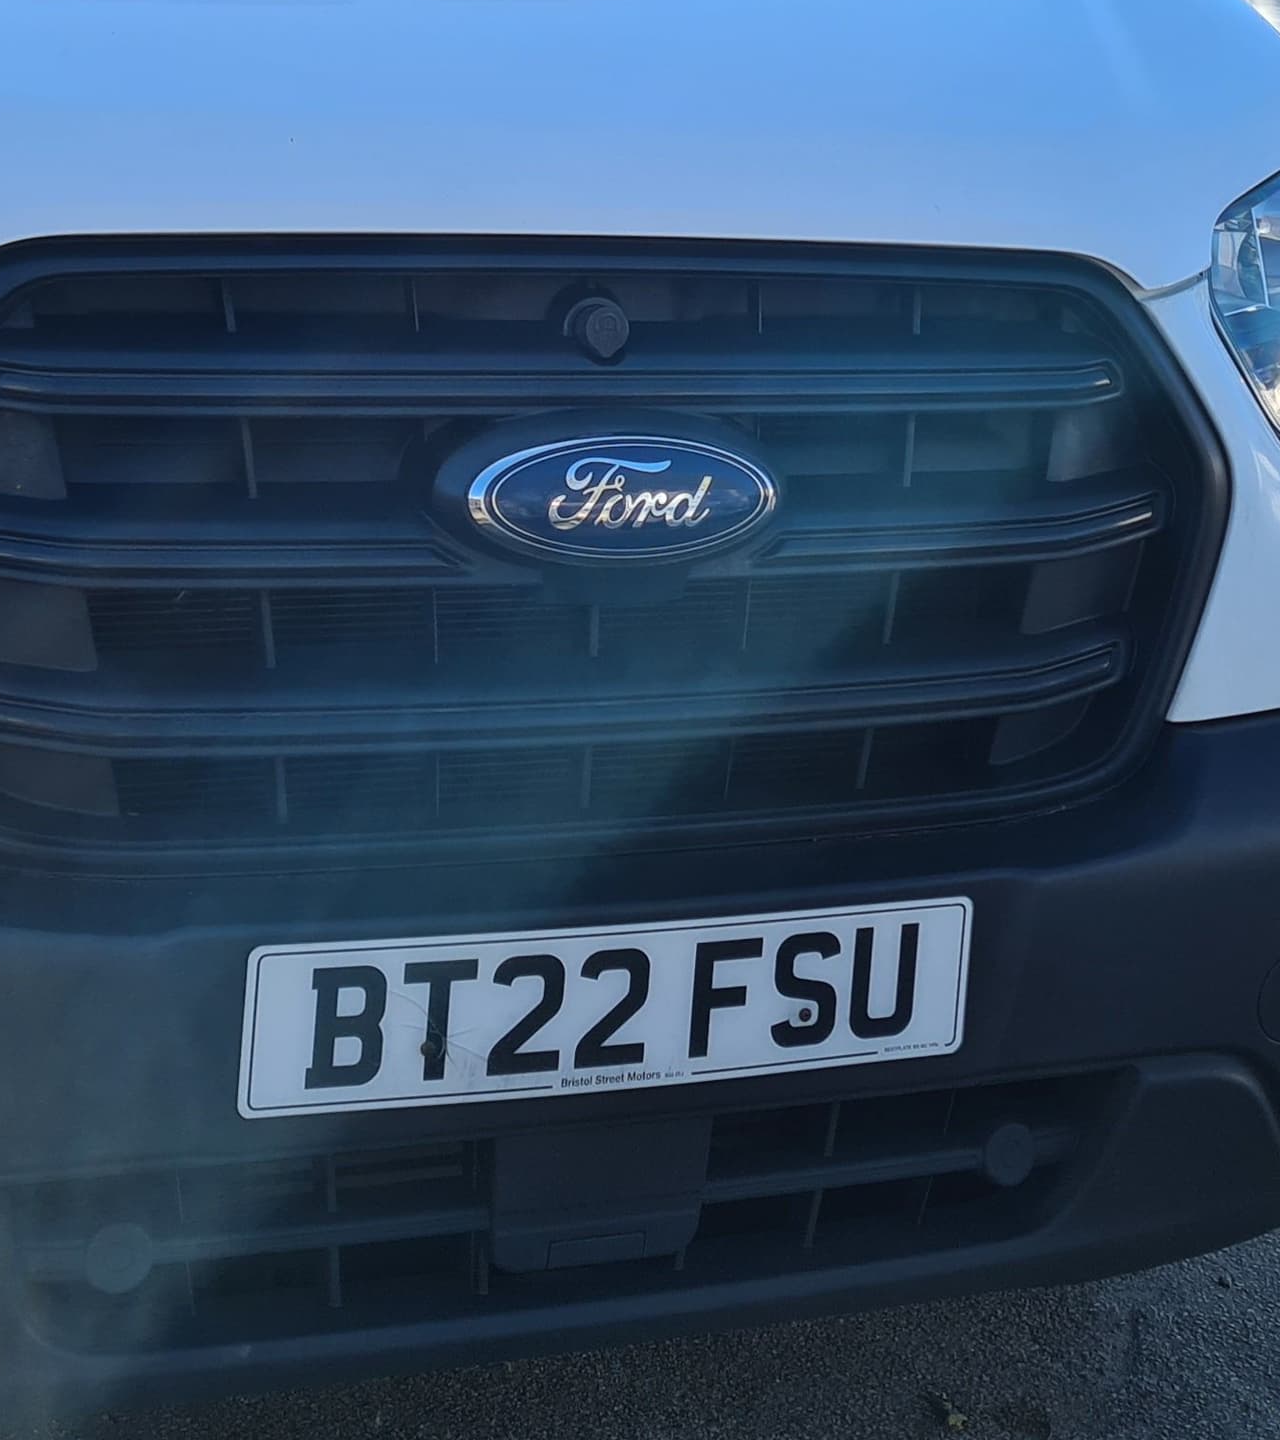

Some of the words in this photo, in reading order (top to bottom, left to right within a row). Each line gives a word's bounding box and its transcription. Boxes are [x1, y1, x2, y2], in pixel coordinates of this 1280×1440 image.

[548, 457, 712, 530] Ford
[305, 954, 652, 1090] BT22
[687, 922, 921, 1058] FSU
[561, 1074, 593, 1088] Bristol
[595, 1072, 625, 1085] Street
[627, 1070, 662, 1082] Motors
